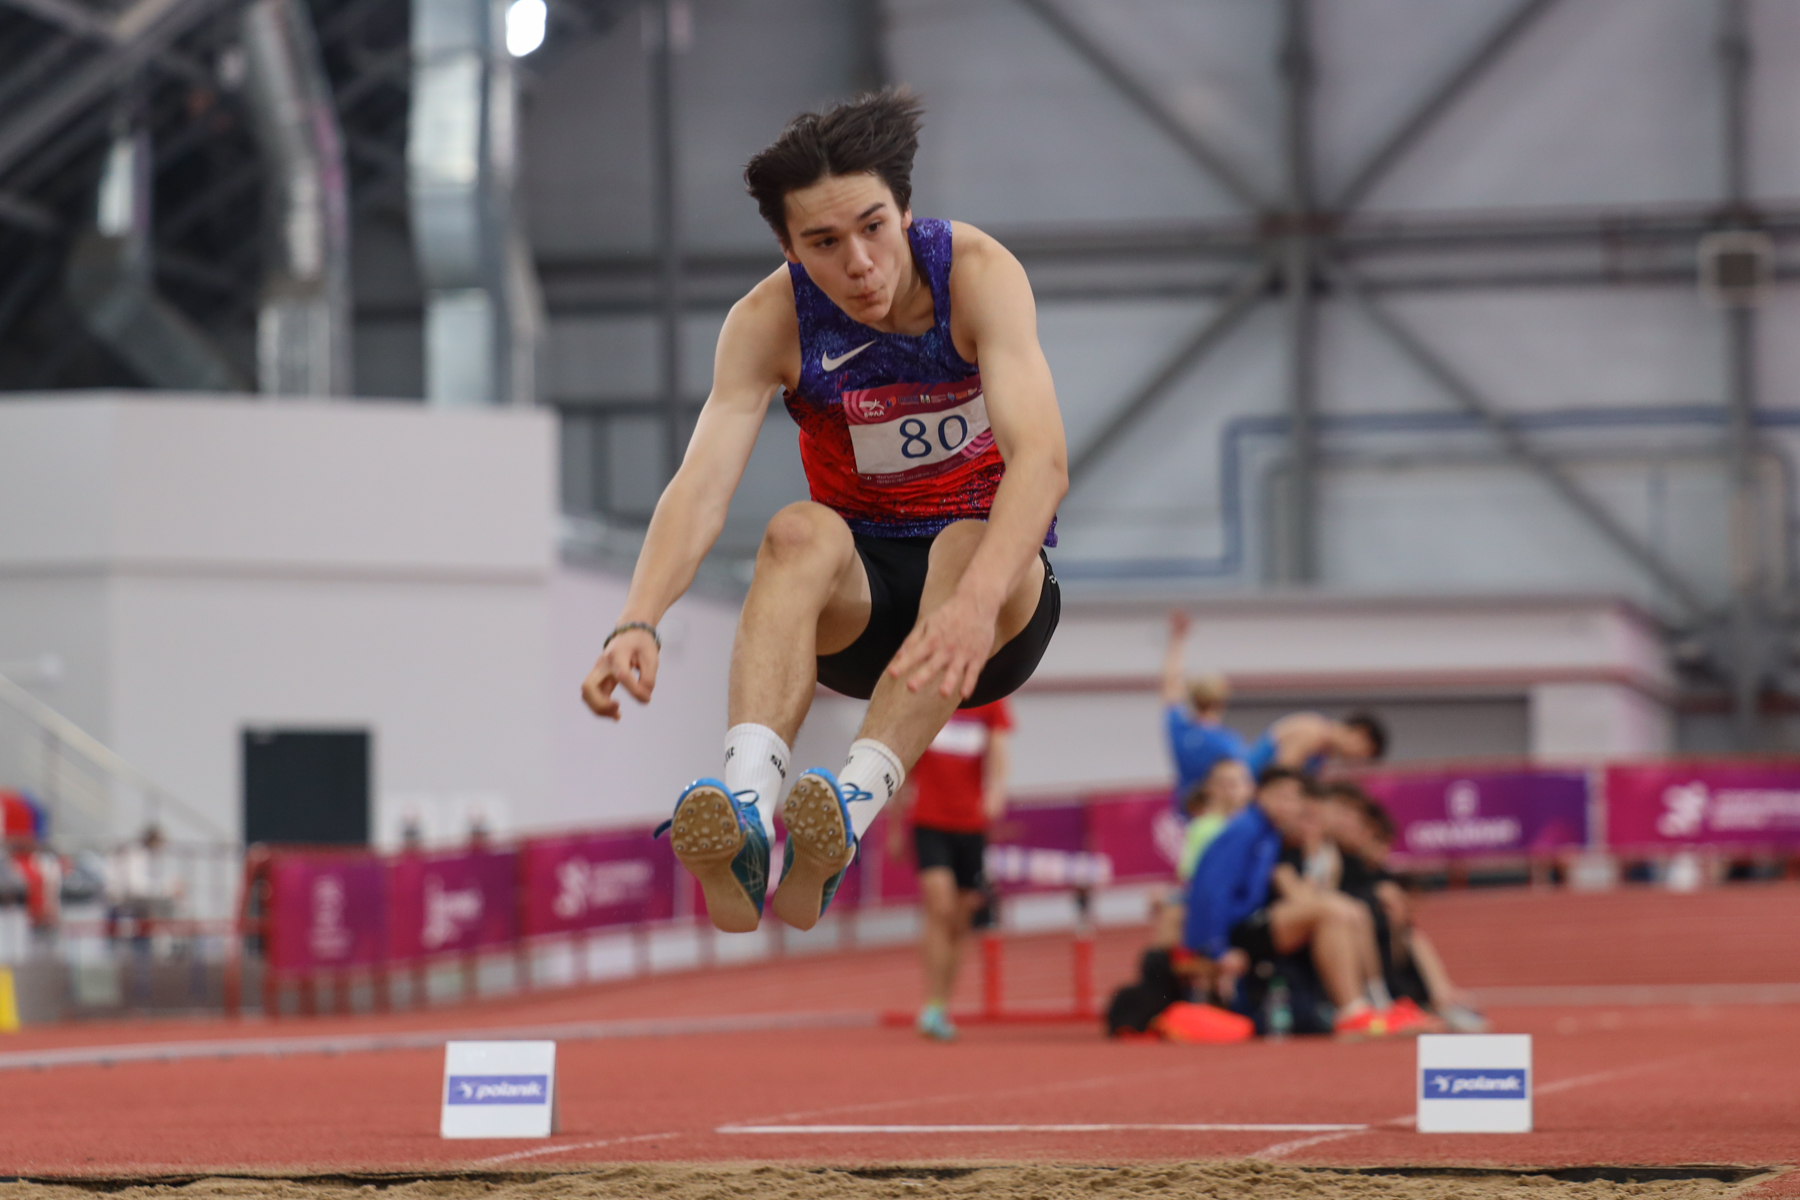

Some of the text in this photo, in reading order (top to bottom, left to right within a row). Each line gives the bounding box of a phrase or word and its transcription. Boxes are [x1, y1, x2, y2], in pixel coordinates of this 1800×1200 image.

[899, 414, 968, 459] 80
[475, 1081, 542, 1100] polanik
[1451, 1075, 1520, 1094] polanik
